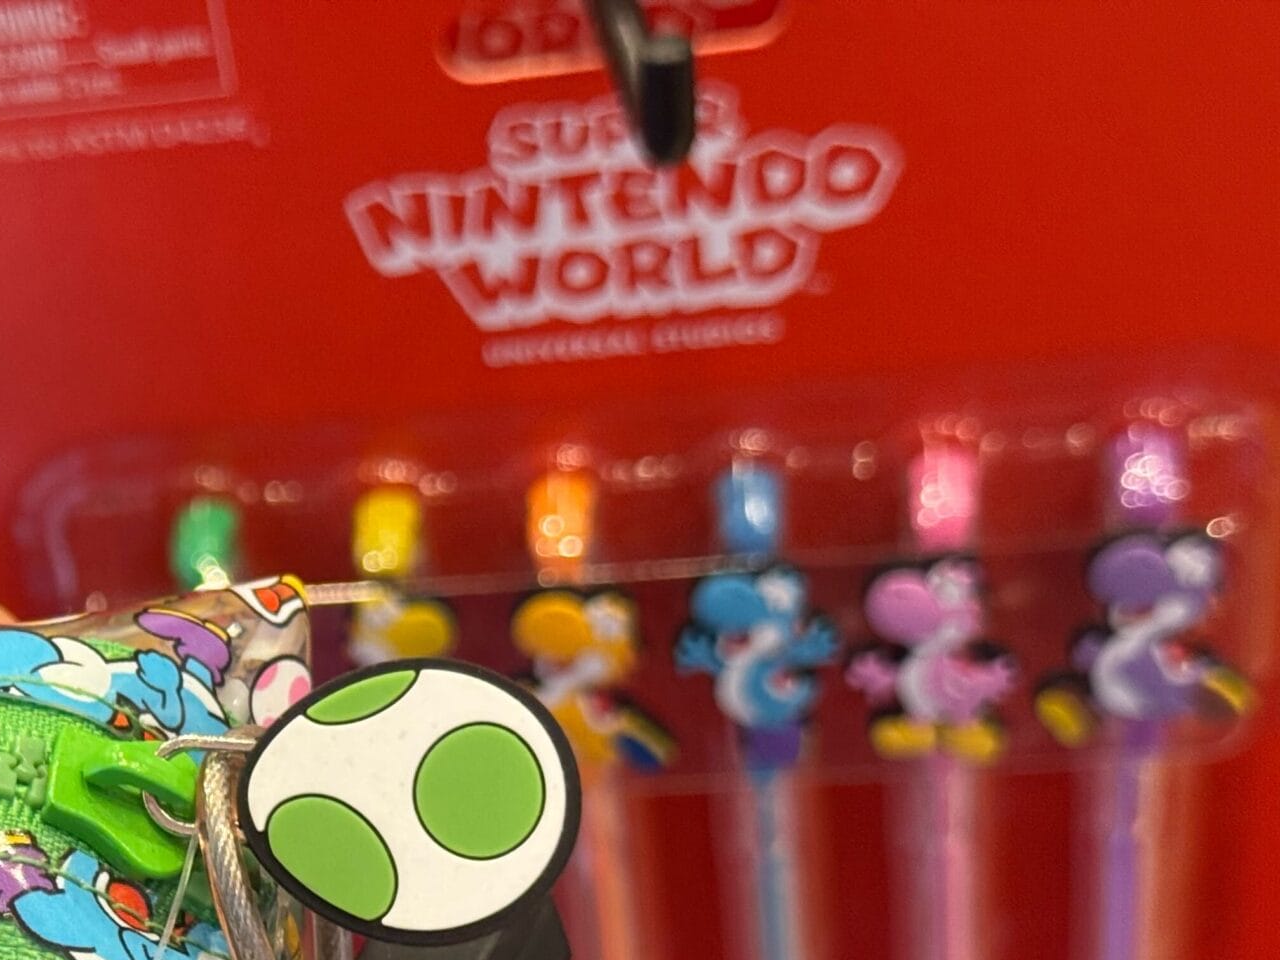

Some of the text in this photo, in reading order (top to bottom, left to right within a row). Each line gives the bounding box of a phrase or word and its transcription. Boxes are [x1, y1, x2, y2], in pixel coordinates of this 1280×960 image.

[498, 86, 738, 166] SUPR
[354, 136, 892, 270] NINTENDO
[458, 226, 808, 320] WORLD
